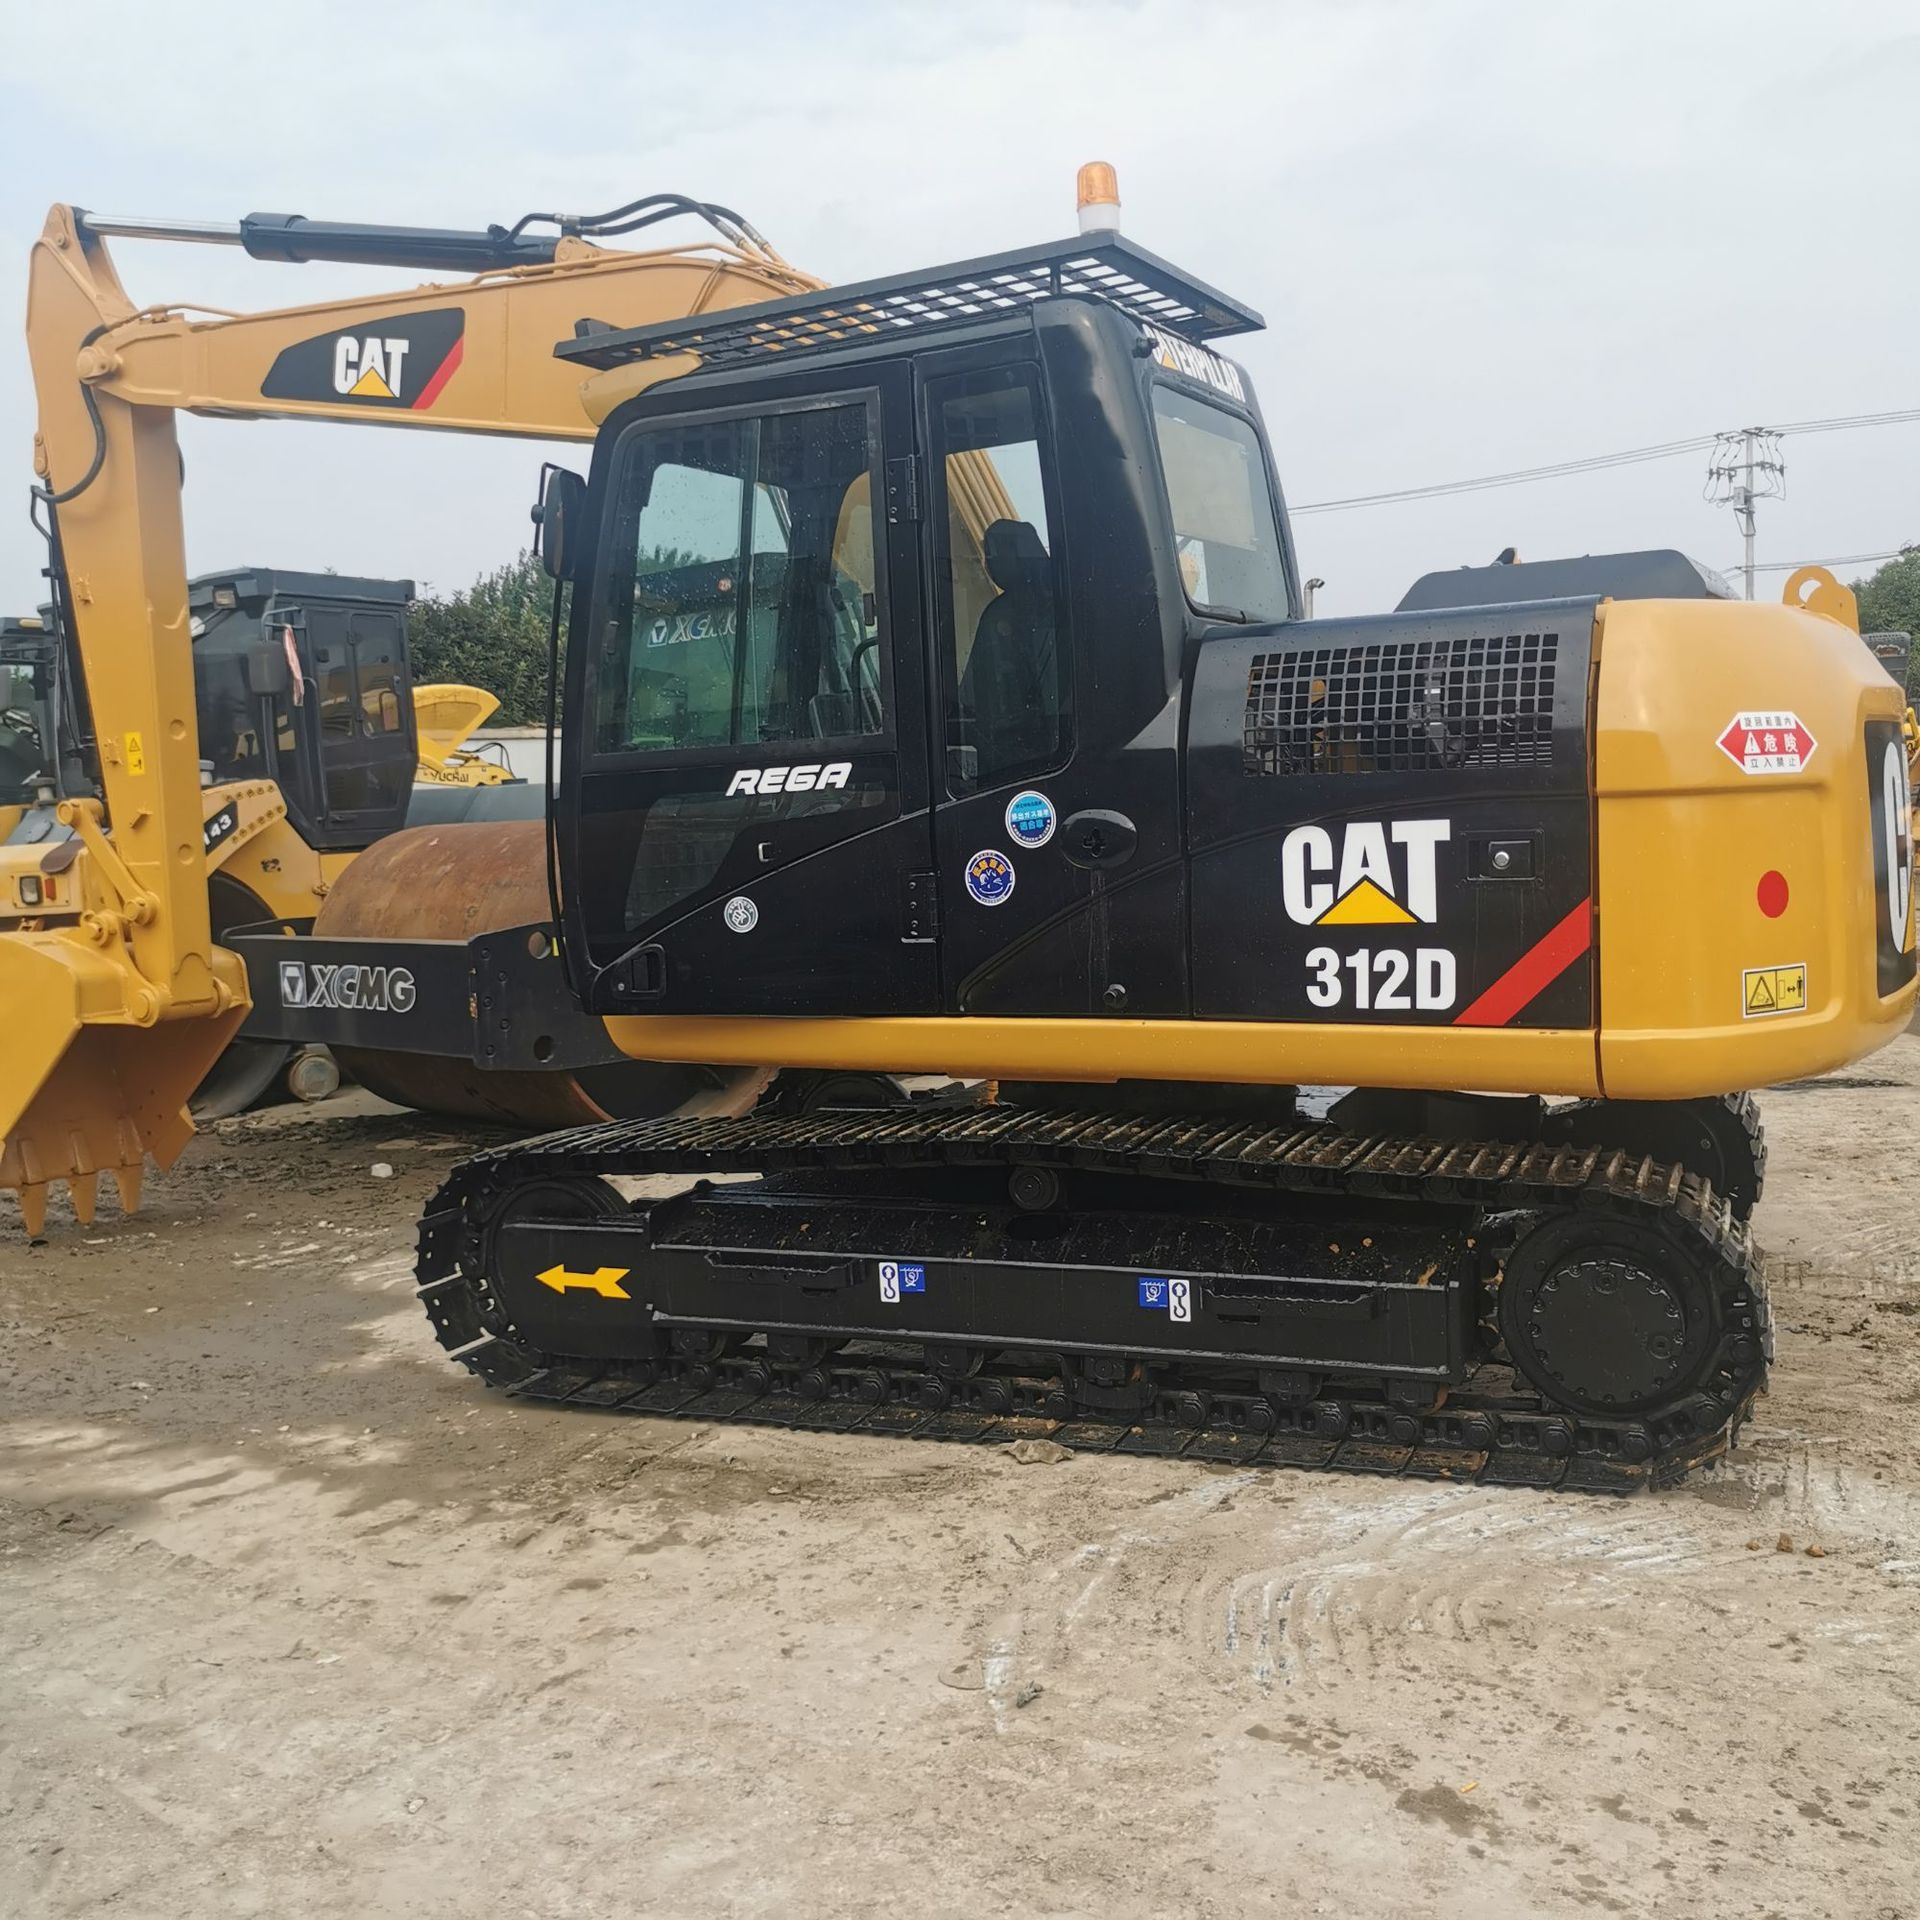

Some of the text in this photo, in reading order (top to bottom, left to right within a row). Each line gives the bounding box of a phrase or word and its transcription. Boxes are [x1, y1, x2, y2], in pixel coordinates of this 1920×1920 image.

[334, 336, 409, 398] CAT
[725, 762, 853, 797] REGA
[1282, 819, 1450, 926] CAT
[307, 964, 416, 1013] XCMG
[1305, 947, 1456, 1010] 312D
